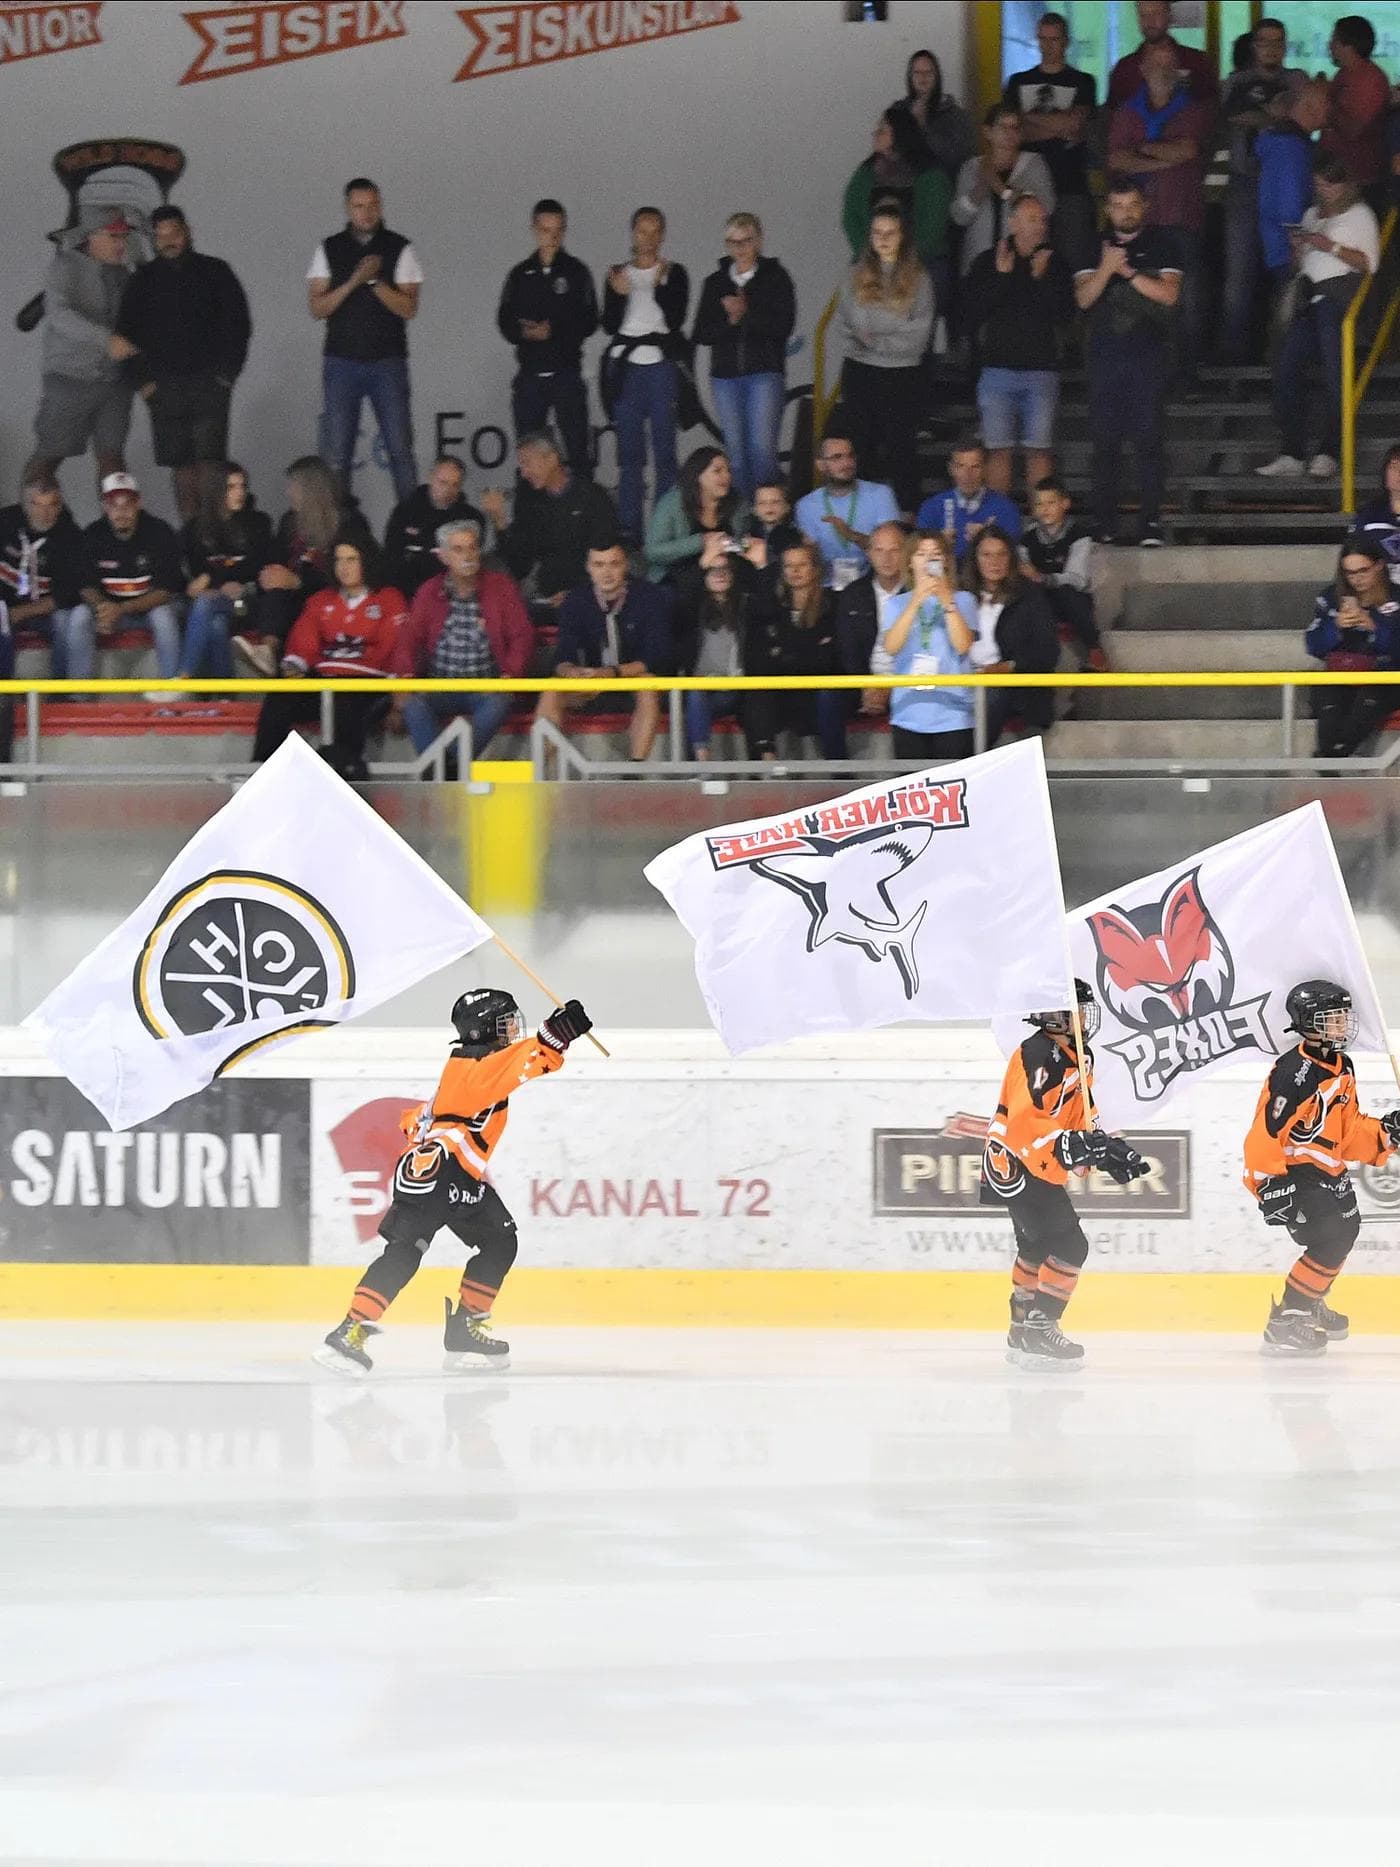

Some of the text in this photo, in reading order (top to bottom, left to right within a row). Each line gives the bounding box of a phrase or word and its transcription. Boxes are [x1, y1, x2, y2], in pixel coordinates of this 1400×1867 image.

[198, 2, 404, 73] EISFIX
[10, 1129, 282, 1208] SATURN
[530, 1178, 771, 1217] KANAL 72
